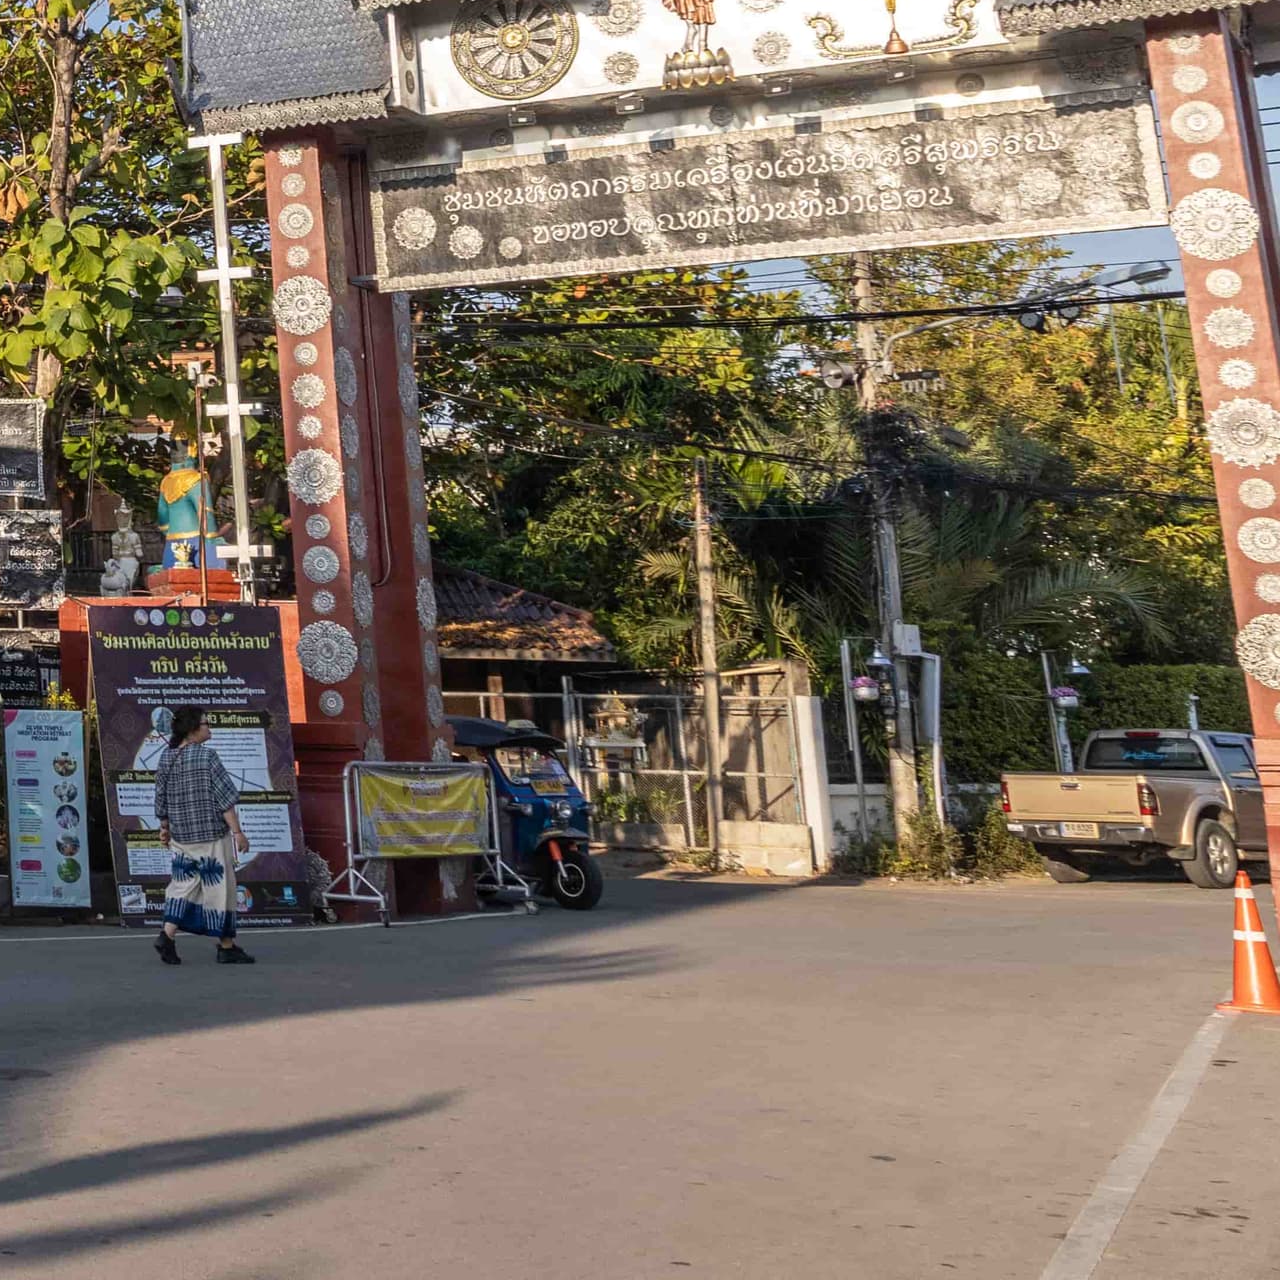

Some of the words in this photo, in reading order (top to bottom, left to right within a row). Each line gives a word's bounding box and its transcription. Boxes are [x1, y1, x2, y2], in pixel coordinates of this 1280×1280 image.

[532, 178, 955, 249] ขอขอบคุณทุกท่านที่มาเยือน
[150, 655, 178, 673] ทริป
[185, 652, 228, 673] ครึ่งวัน
